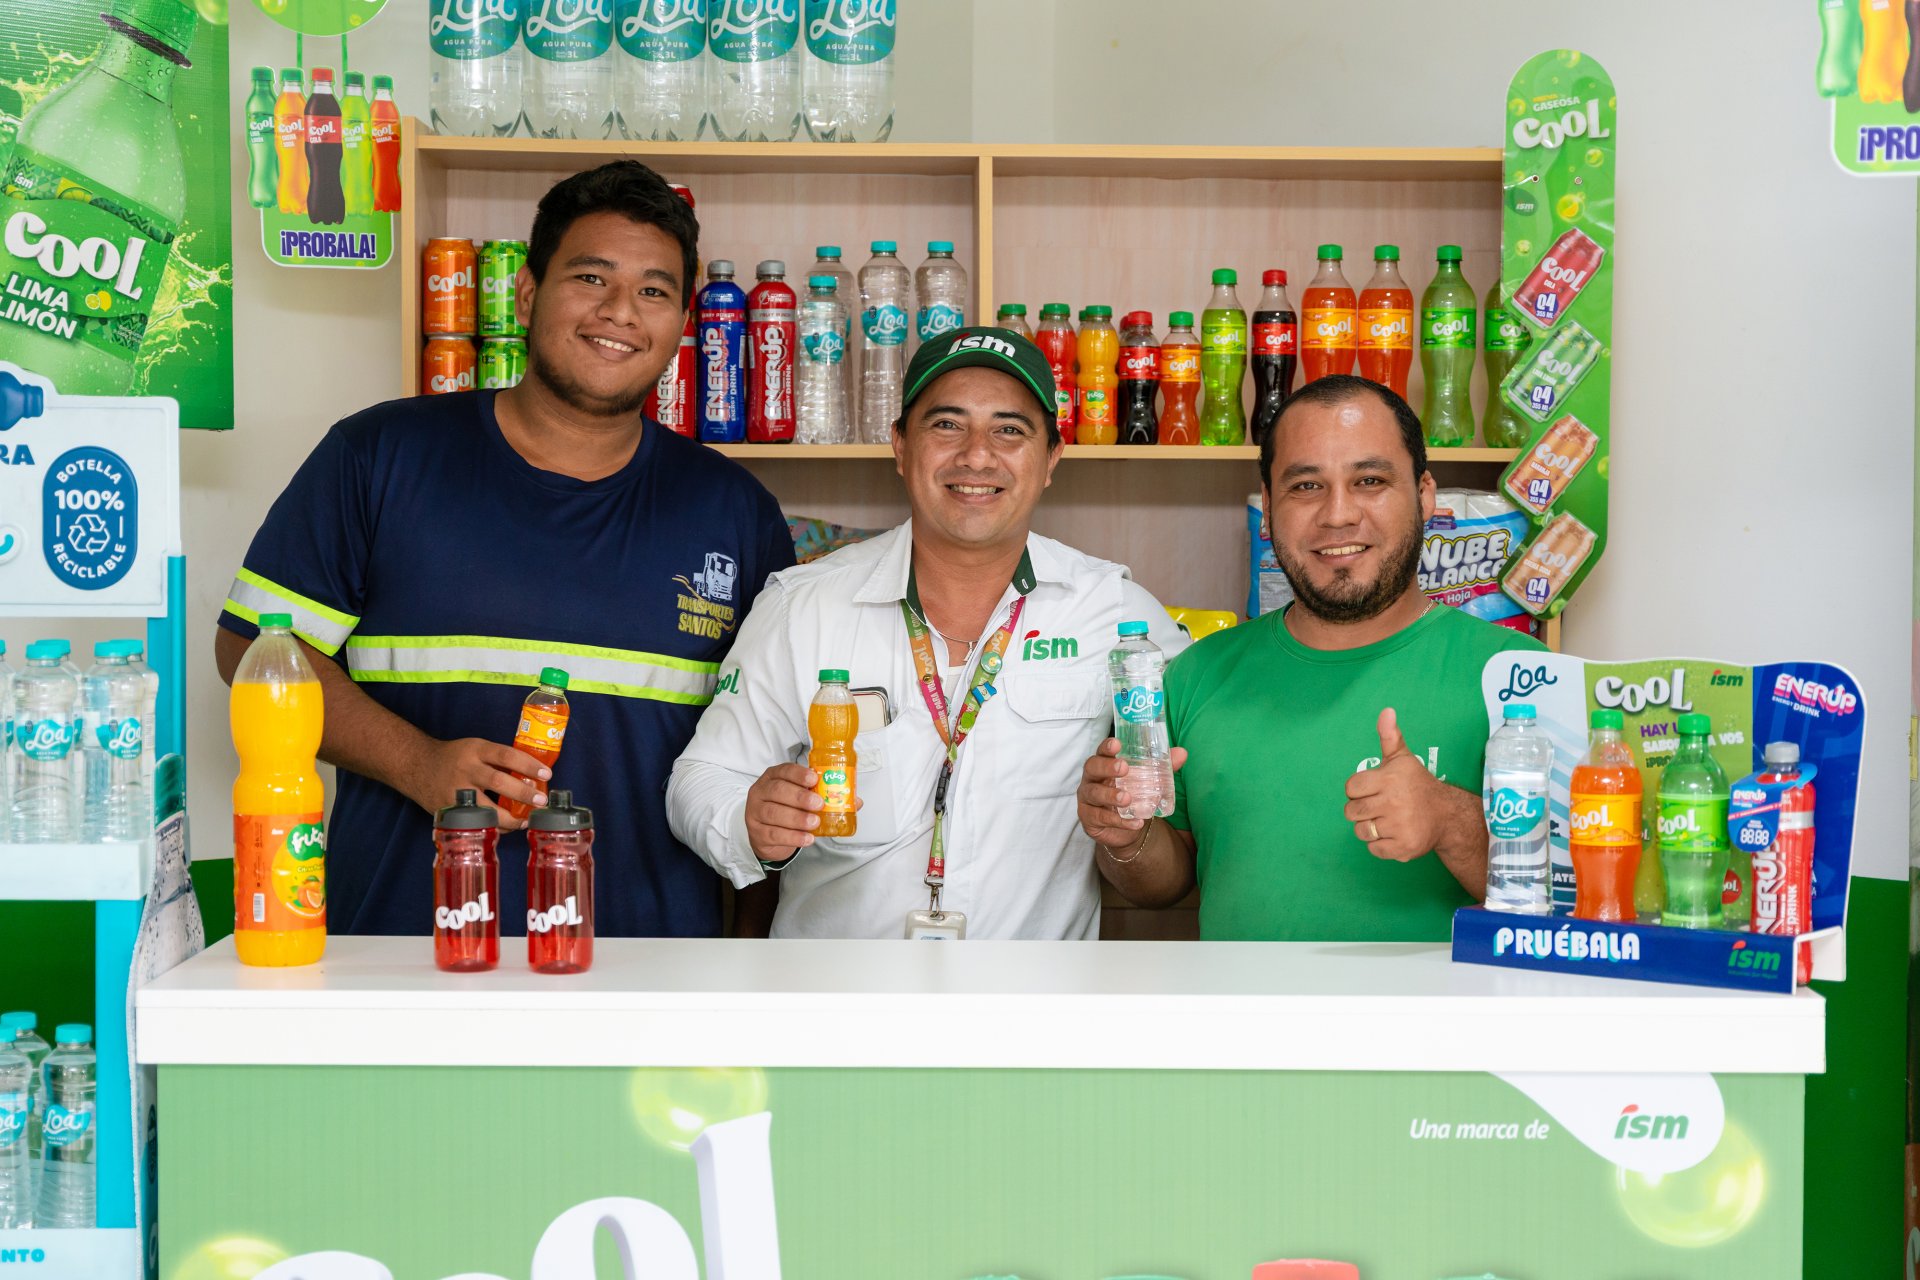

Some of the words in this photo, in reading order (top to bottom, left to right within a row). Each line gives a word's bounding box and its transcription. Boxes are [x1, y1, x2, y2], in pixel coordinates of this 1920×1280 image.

[567, 51, 578, 59] 3L
[665, 51, 676, 59] 3L
[1533, 97, 1580, 112] GASEOSA
[1513, 98, 1610, 148] COOL
[15, 173, 34, 189] ism
[281, 230, 377, 259] ¡PROBALA!
[428, 266, 475, 292] COOL
[6, 274, 69, 312] LIMA
[1537, 293, 1556, 311] Q4
[0, 300, 78, 339] LIMÓN
[868, 309, 906, 335] Loa
[921, 309, 961, 335] Loa
[812, 335, 844, 354] Loa
[1533, 386, 1552, 404] Q4
[56, 459, 122, 485] BOTELLA
[54, 489, 125, 511] 100%
[1530, 480, 1549, 497] Q4
[53, 543, 127, 579] RECICLABLE
[1417, 532, 1507, 573] NUBE
[1447, 591, 1471, 604] Hoja
[1528, 578, 1547, 596] Q4
[677, 594, 734, 621] TRANSPORTES
[678, 612, 722, 640] SANTOS
[1022, 630, 1078, 661] ism
[1499, 663, 1558, 702] Loa
[1595, 668, 1693, 713] COOL
[1710, 670, 1743, 687] ism
[1122, 692, 1160, 715] Loa
[1774, 673, 1857, 716] ENERUP
[1793, 702, 1820, 718] DRINK
[25, 724, 70, 750] Loa
[1640, 723, 1668, 738] HAY
[1719, 731, 1745, 746] VOS
[1490, 793, 1536, 824] Loa
[435, 892, 494, 930] COOL
[1787, 884, 1797, 926] DRINK
[1495, 924, 1641, 962] PRUÉBALA
[1728, 940, 1781, 971] ism
[42, 1108, 82, 1134] Loa
[1410, 1118, 1450, 1140] Una
[1456, 1121, 1518, 1140] marca
[1524, 1119, 1550, 1140] de
[1614, 1104, 1690, 1140] ism
